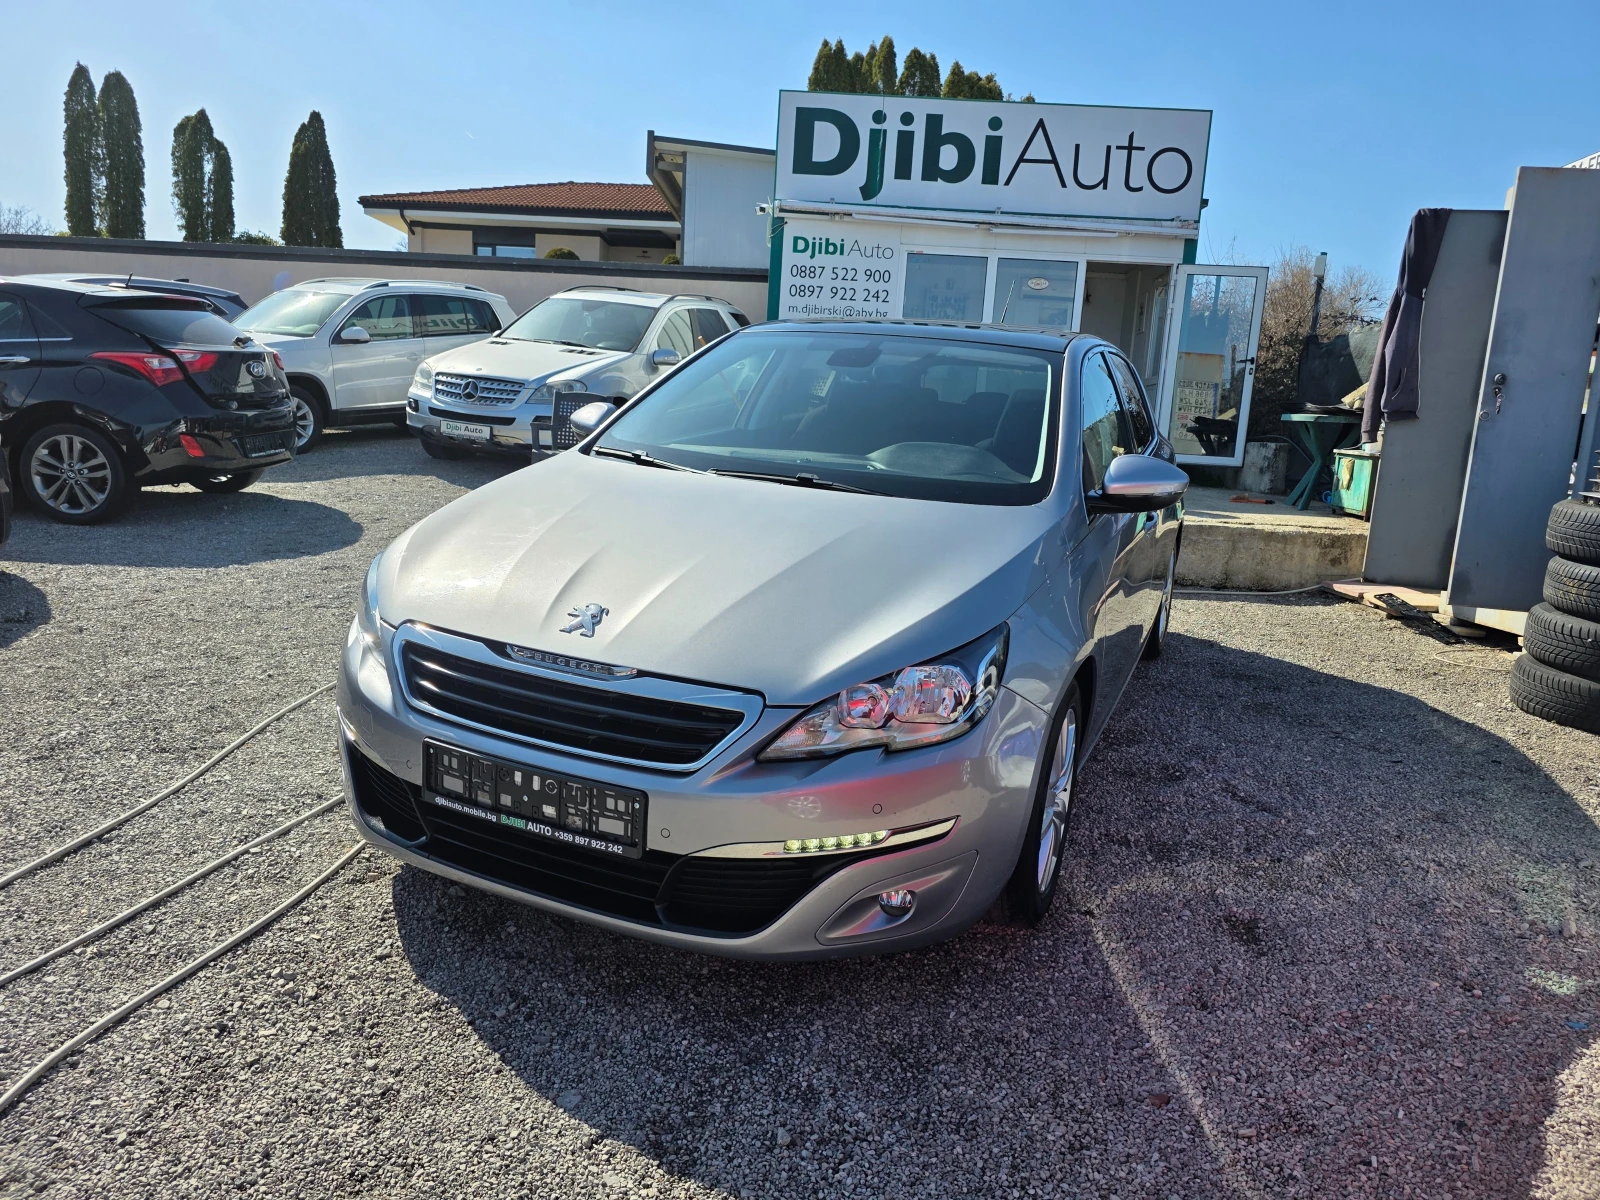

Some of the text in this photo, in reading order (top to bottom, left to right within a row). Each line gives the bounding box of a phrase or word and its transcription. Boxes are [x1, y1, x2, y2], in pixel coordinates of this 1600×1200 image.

[792, 236, 894, 260] Djibi Auto
[790, 264, 891, 283] 0887 522 900
[789, 284, 890, 303] 0897 922 242
[446, 423, 483, 434] Djibi Auto
[434, 796, 623, 854] djibiauto.mobile.bg DJIBI AUTO +359 897 922 242
